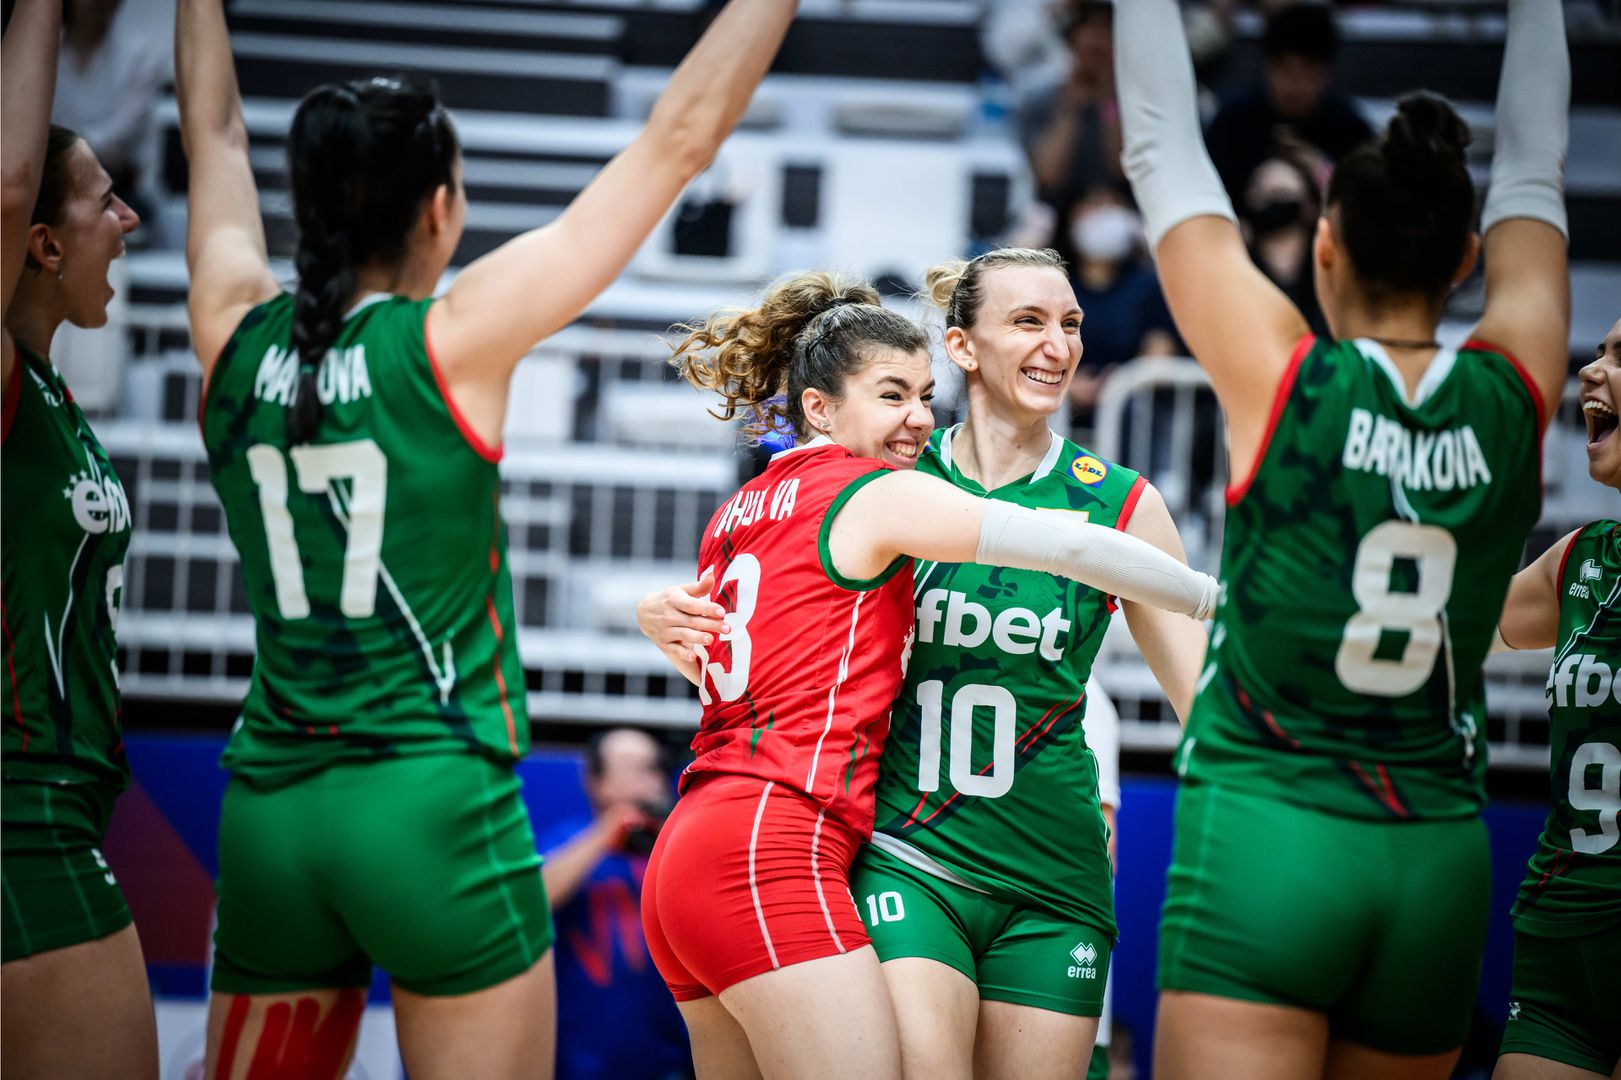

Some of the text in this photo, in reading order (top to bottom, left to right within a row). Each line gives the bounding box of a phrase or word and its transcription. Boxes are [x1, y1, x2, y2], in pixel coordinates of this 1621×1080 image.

[246, 438, 387, 620] 17
[916, 588, 1072, 662] fbet
[1335, 519, 1458, 698] 8
[916, 679, 1017, 799] 10
[1568, 742, 1621, 855] 9
[866, 891, 906, 927] 10
[1067, 965, 1097, 979] errea
